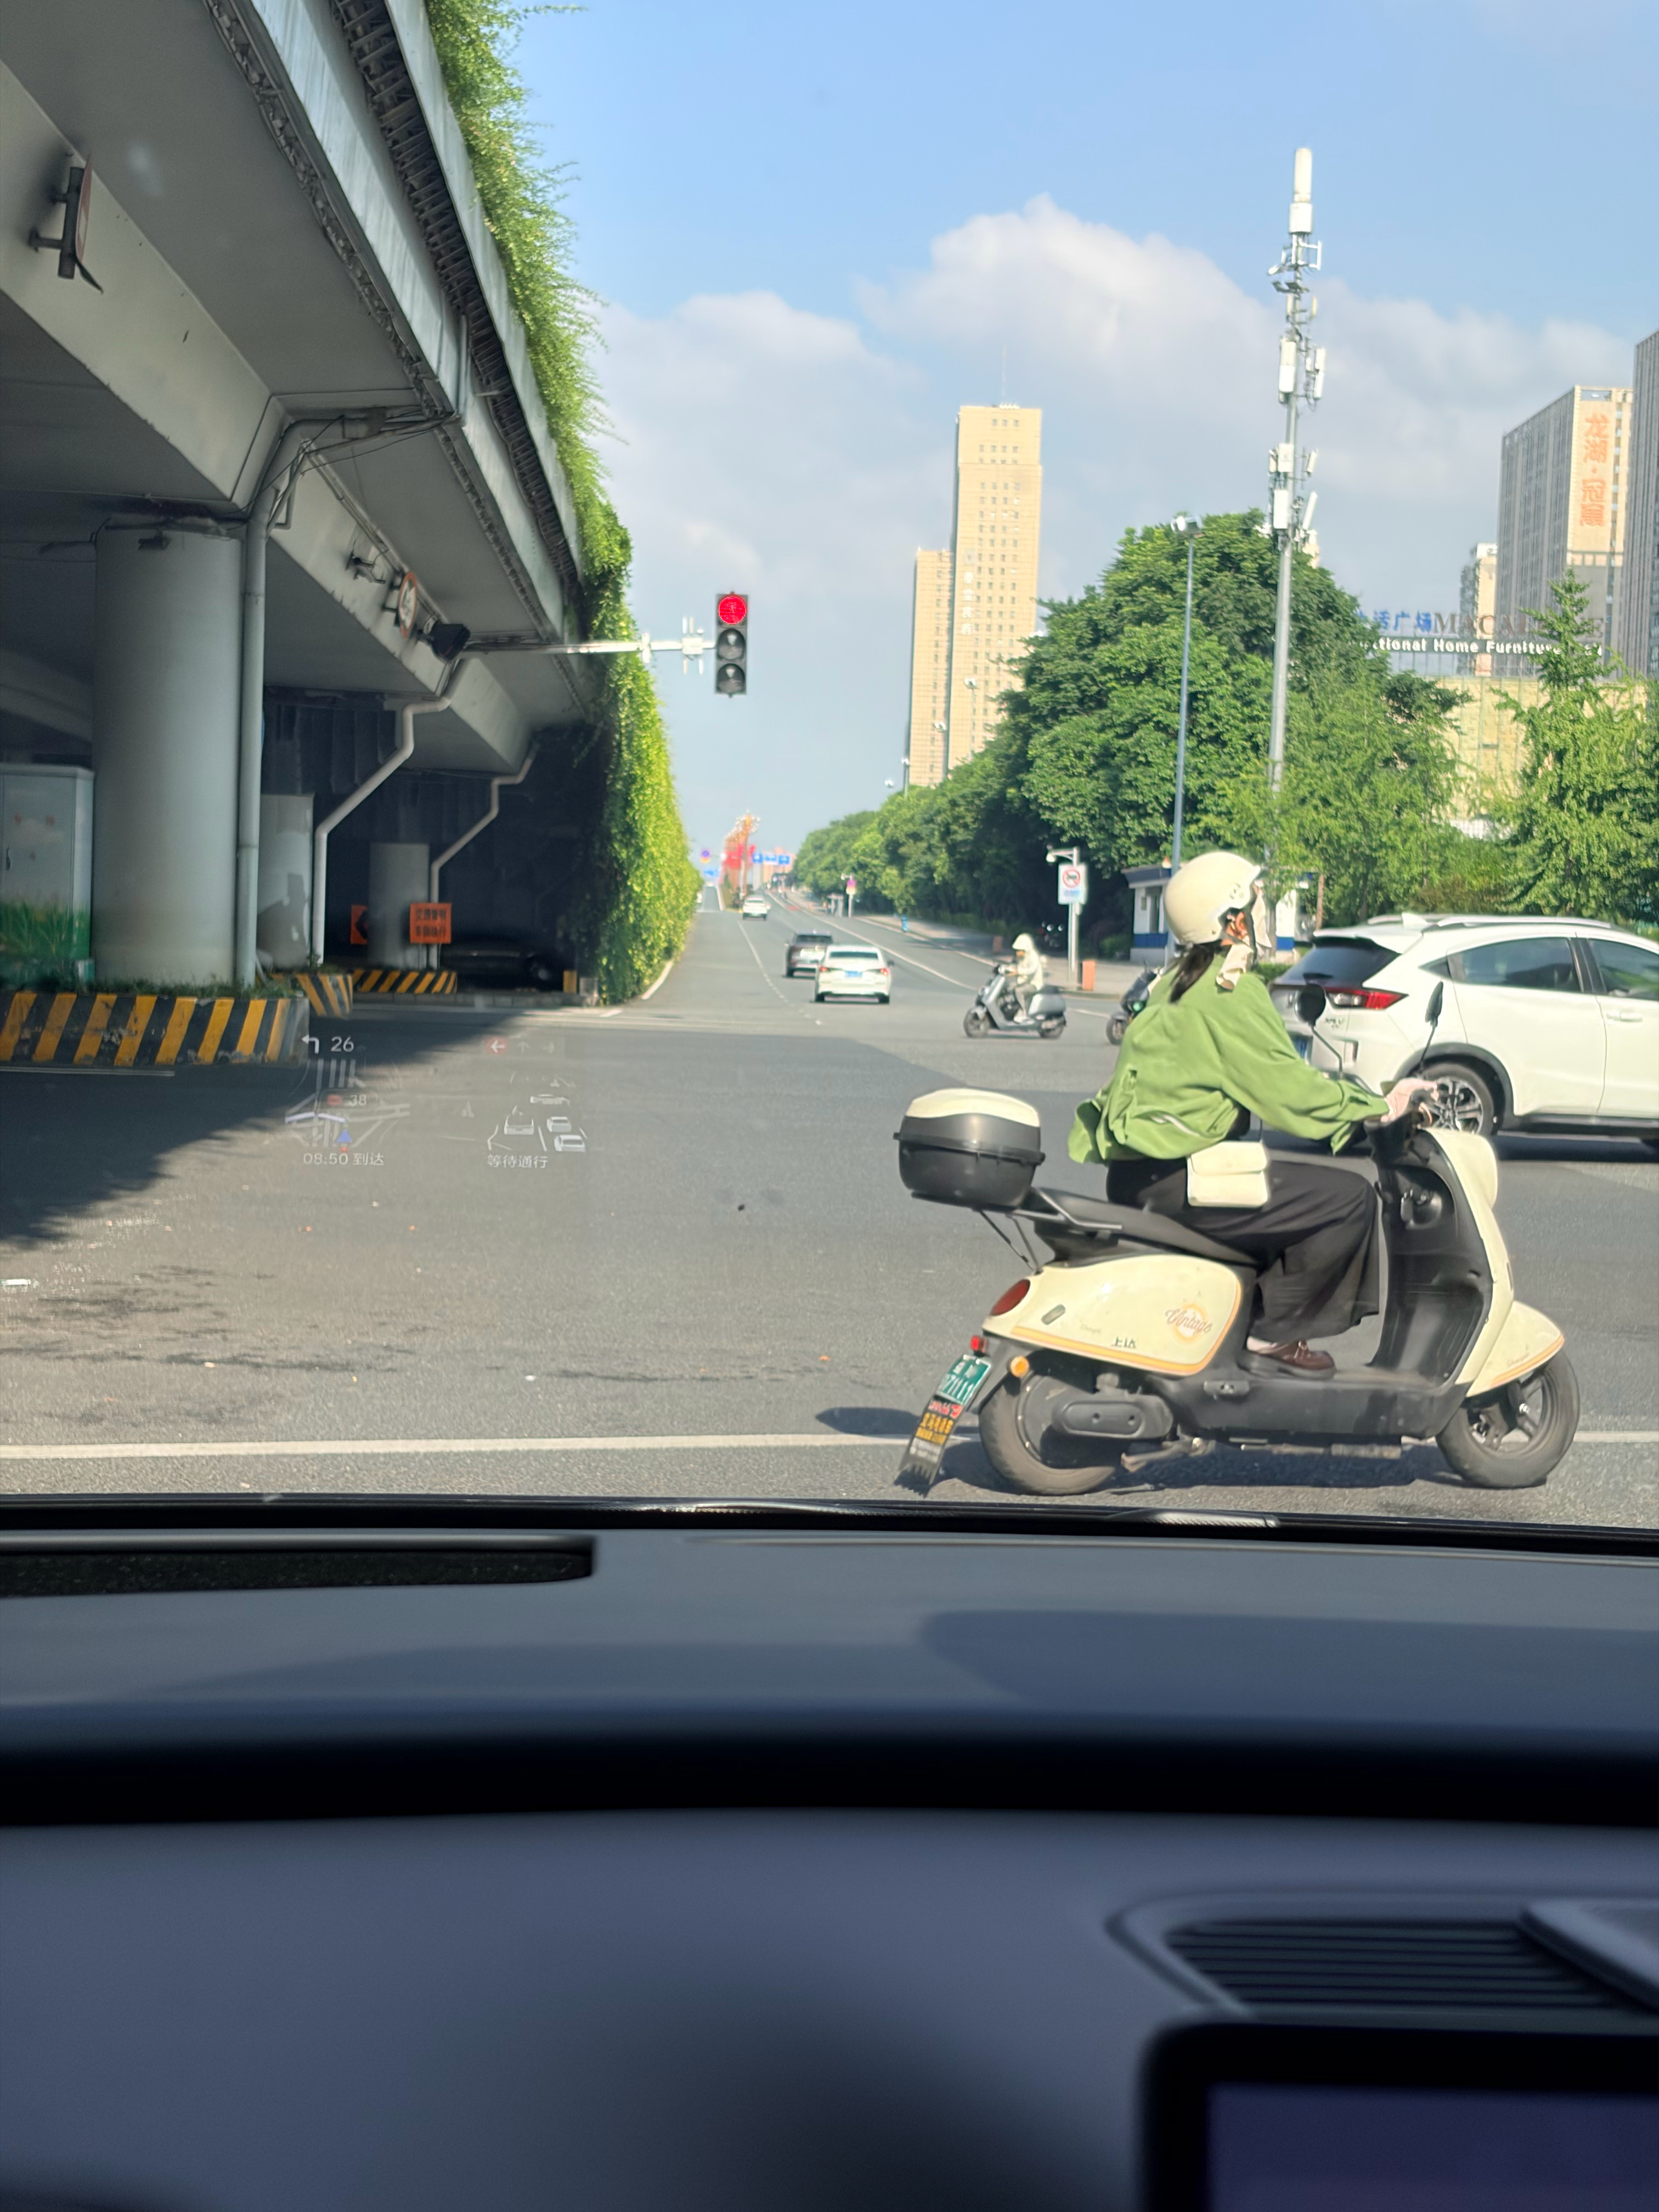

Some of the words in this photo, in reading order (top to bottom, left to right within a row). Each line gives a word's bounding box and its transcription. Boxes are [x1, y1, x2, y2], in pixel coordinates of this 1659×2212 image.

[1433, 638, 1479, 653] Home
[331, 1036, 354, 1052] 26
[303, 1153, 348, 1165] 08:50
[352, 1153, 385, 1166] 到达
[487, 1154, 549, 1169] 等待通行
